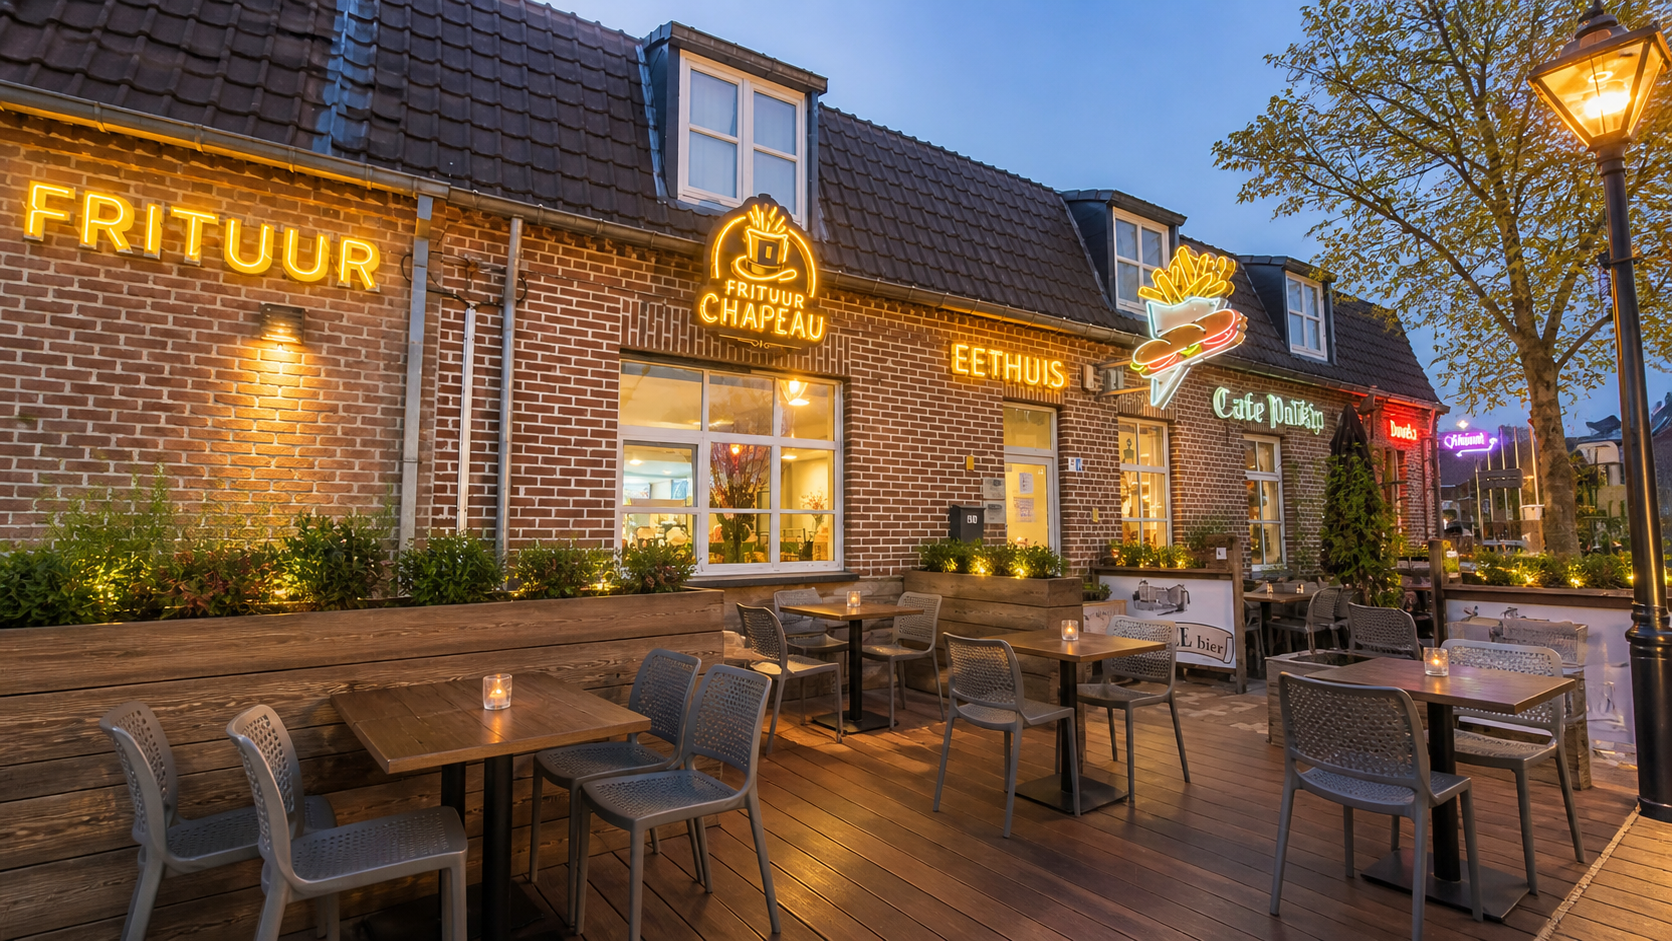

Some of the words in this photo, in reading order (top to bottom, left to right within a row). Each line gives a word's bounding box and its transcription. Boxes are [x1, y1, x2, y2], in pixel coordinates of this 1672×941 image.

[23, 180, 381, 292] FRITUUR
[726, 279, 804, 309] FRITUUR
[700, 293, 824, 340] CHAPEAU
[951, 343, 1067, 389] EETHUIS
[1213, 386, 1265, 423] Cafe
[1197, 635, 1223, 654] bier
